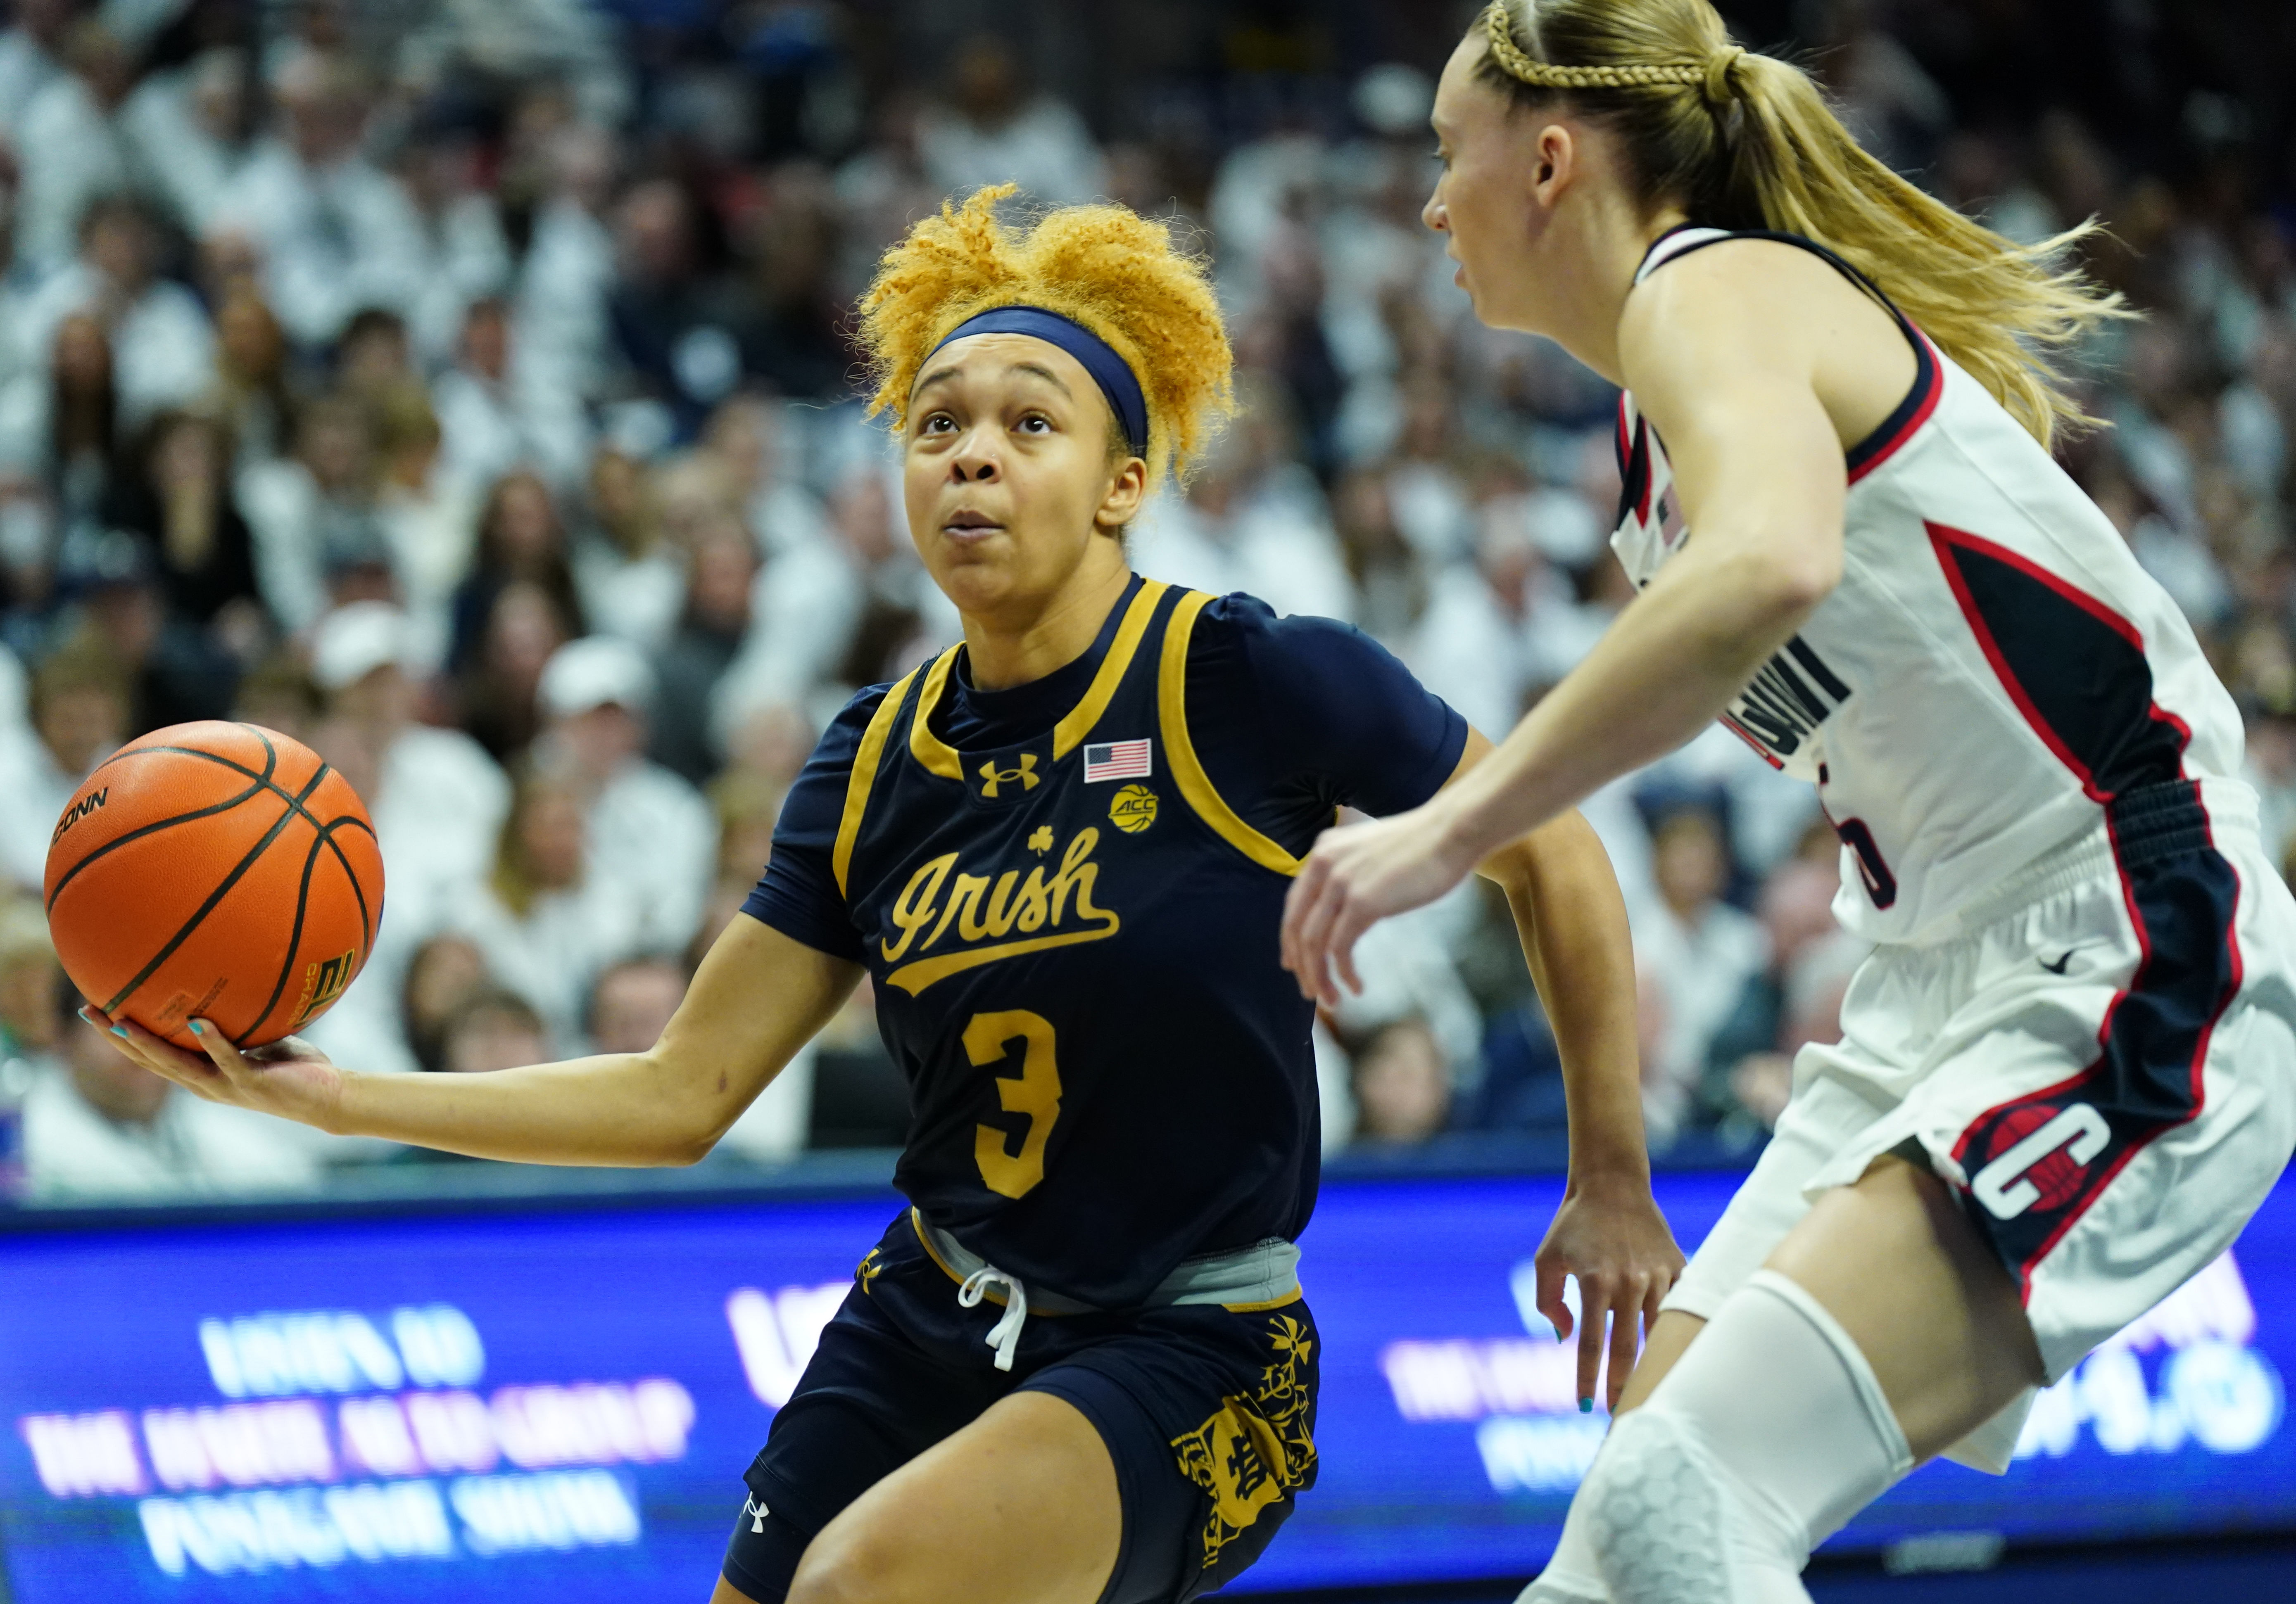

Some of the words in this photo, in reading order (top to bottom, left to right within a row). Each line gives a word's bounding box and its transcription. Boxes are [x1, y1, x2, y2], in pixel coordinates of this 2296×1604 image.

[51, 786, 108, 847] CONN
[1115, 797, 1156, 813] ACC
[881, 826, 1119, 998] Irish
[962, 1009, 1062, 1200] 3
